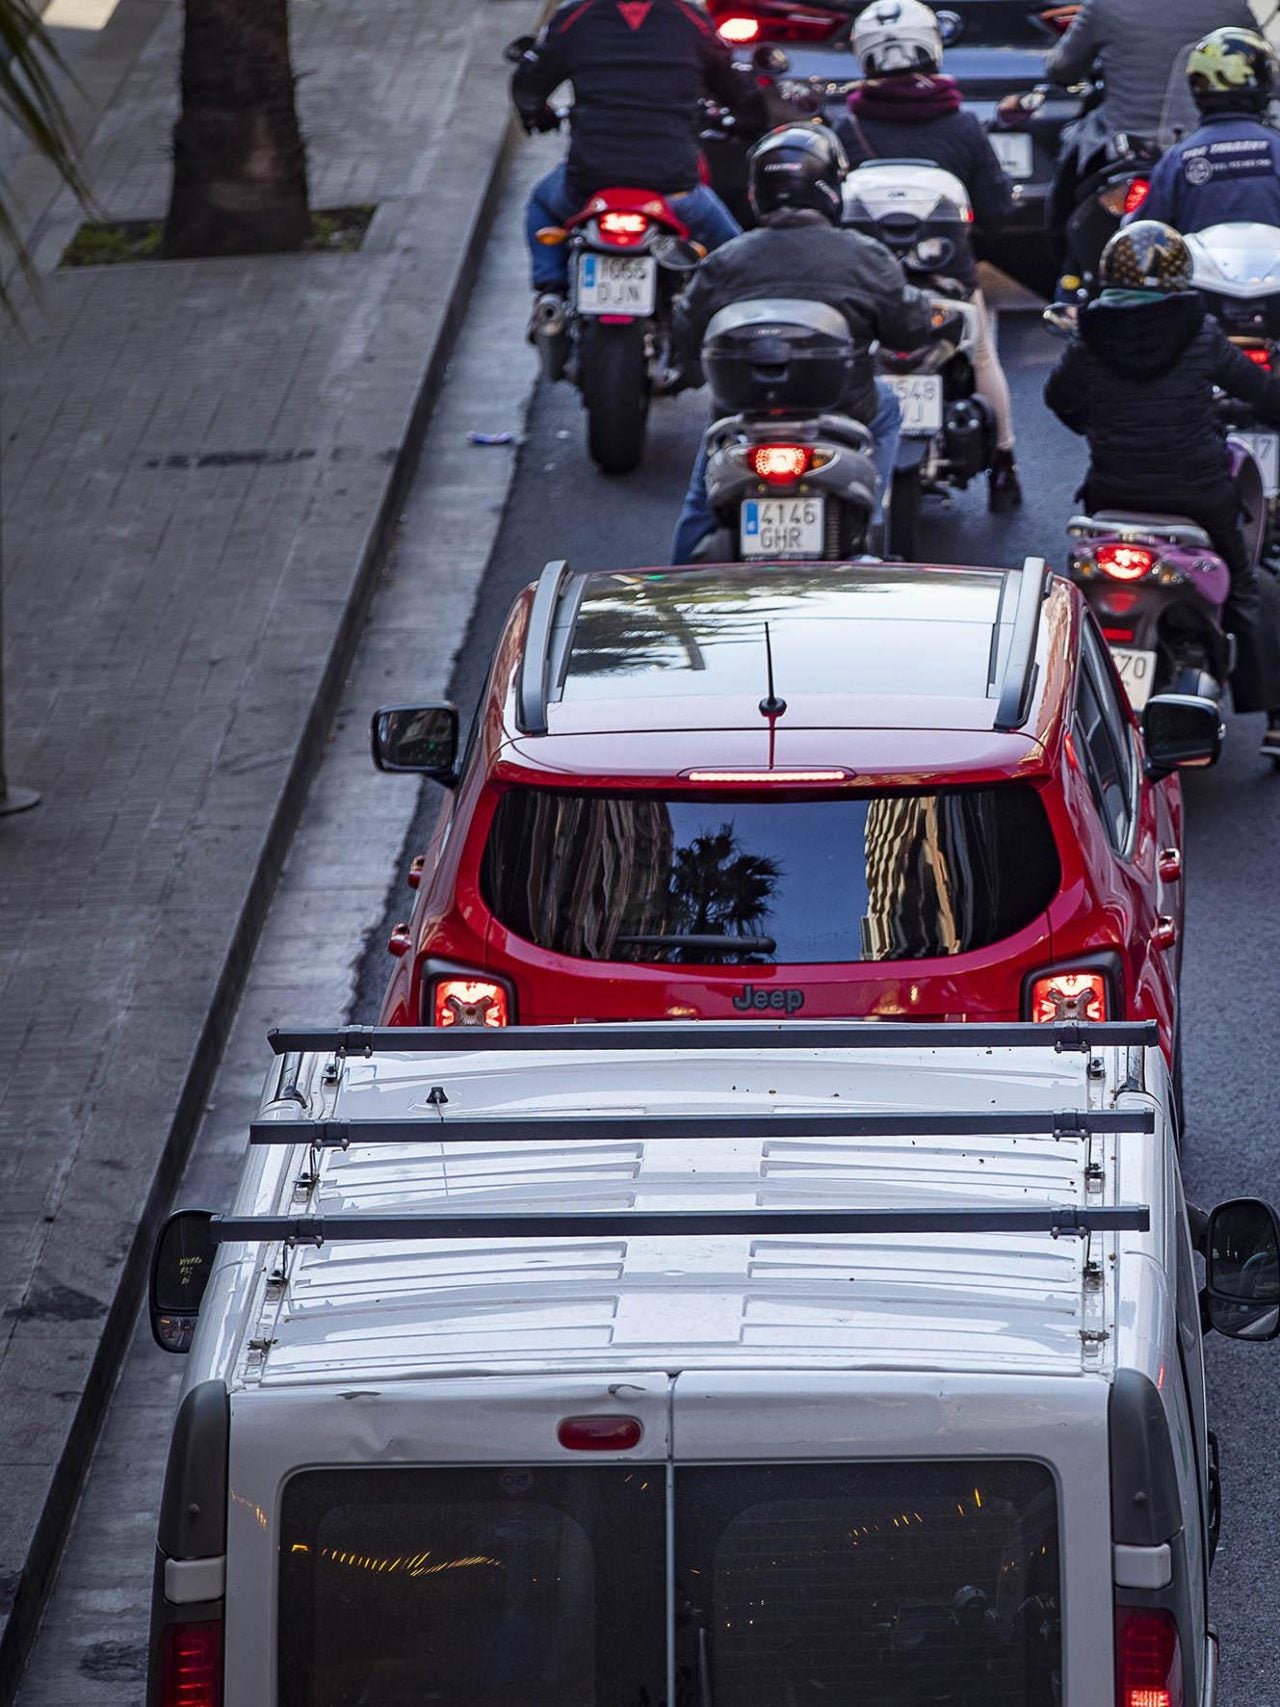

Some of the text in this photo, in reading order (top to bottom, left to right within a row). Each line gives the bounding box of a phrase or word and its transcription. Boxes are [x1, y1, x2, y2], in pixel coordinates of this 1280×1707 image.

[761, 503, 816, 526] 4146
[761, 526, 802, 549] GHR
[733, 983, 805, 1014] Jeep
